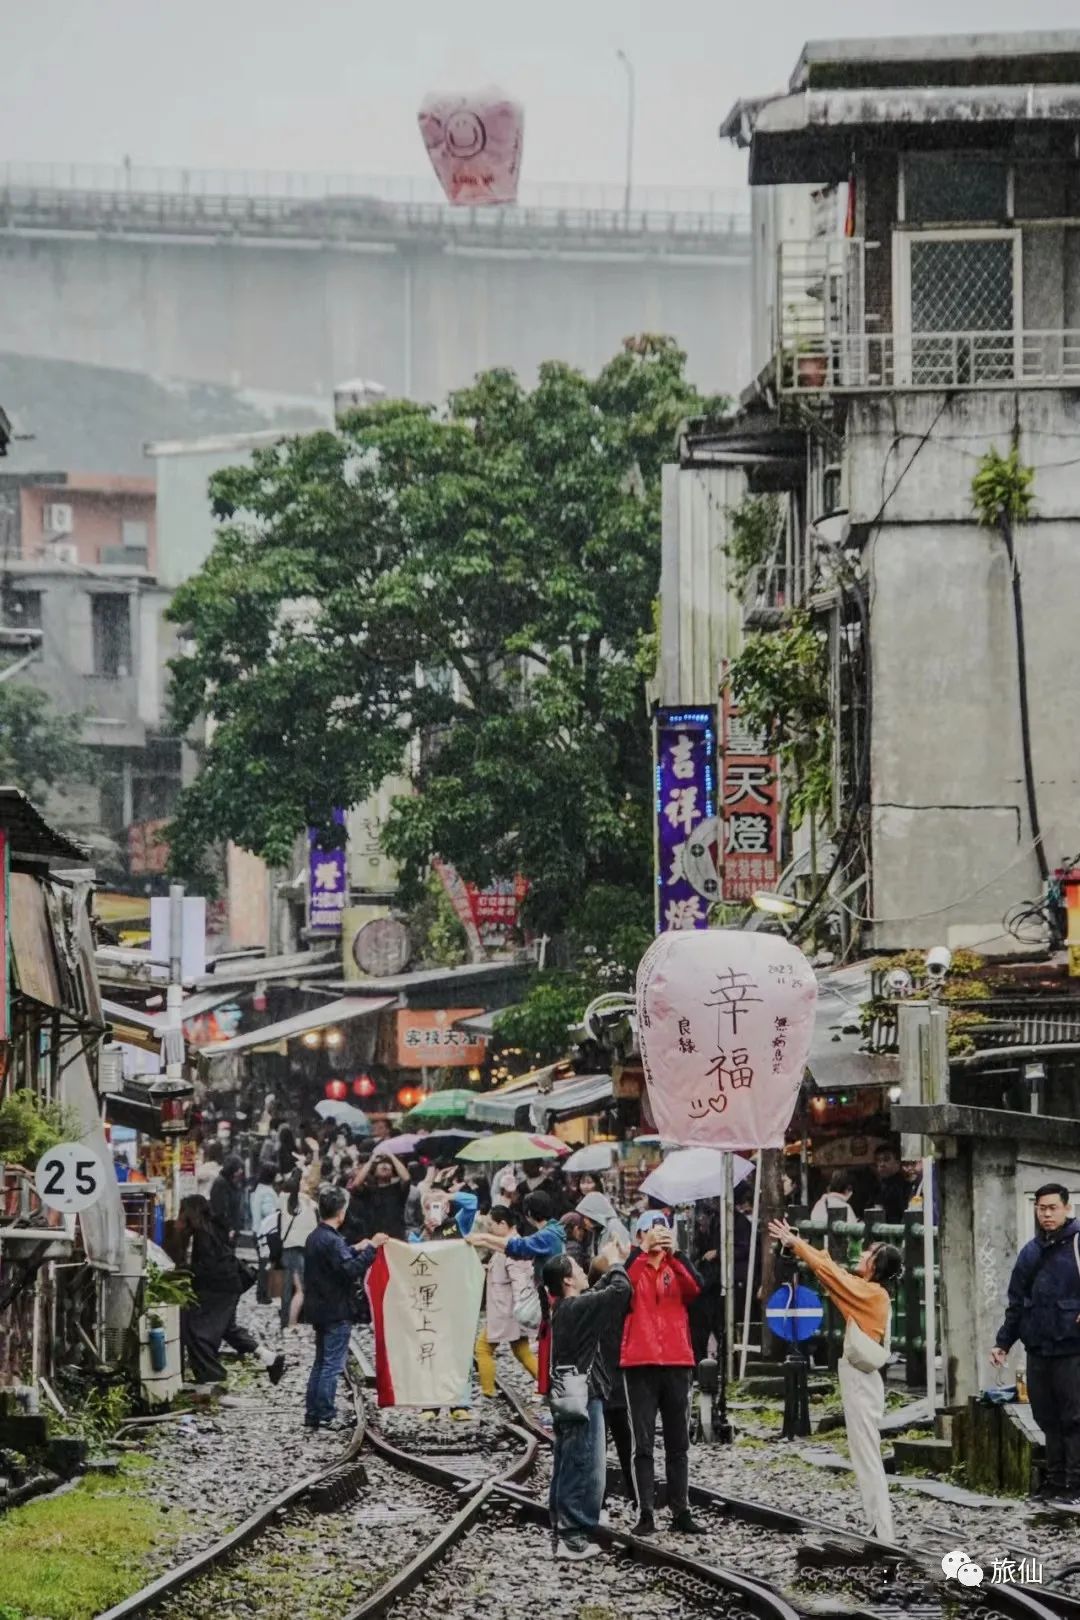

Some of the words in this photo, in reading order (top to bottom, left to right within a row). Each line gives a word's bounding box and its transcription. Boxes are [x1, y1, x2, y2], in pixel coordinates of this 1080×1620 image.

[704, 967, 764, 1091] 幸福
[43, 1159, 97, 1196] 25
[409, 1251, 442, 1366] 金運上昇
